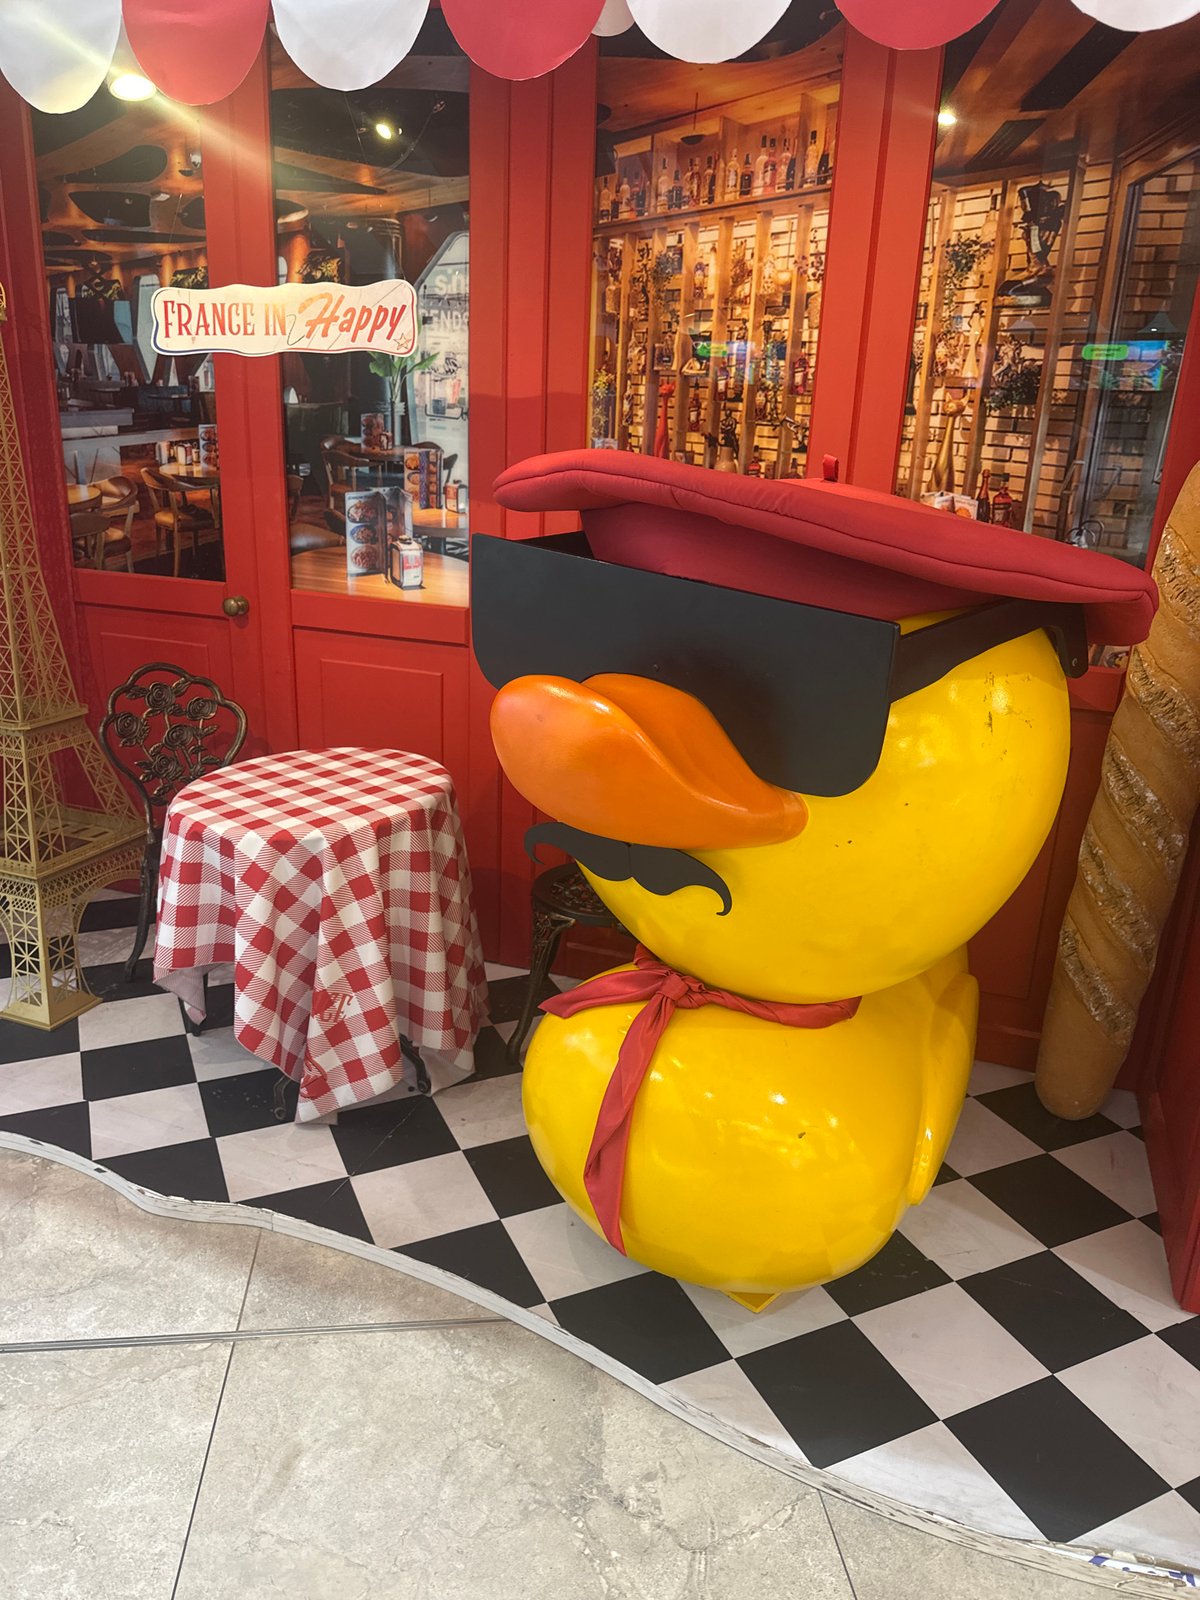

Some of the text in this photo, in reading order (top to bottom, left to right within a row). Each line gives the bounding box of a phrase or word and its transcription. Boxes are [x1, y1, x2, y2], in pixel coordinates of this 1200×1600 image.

[162, 291, 407, 343] FRANCE IN Happy
